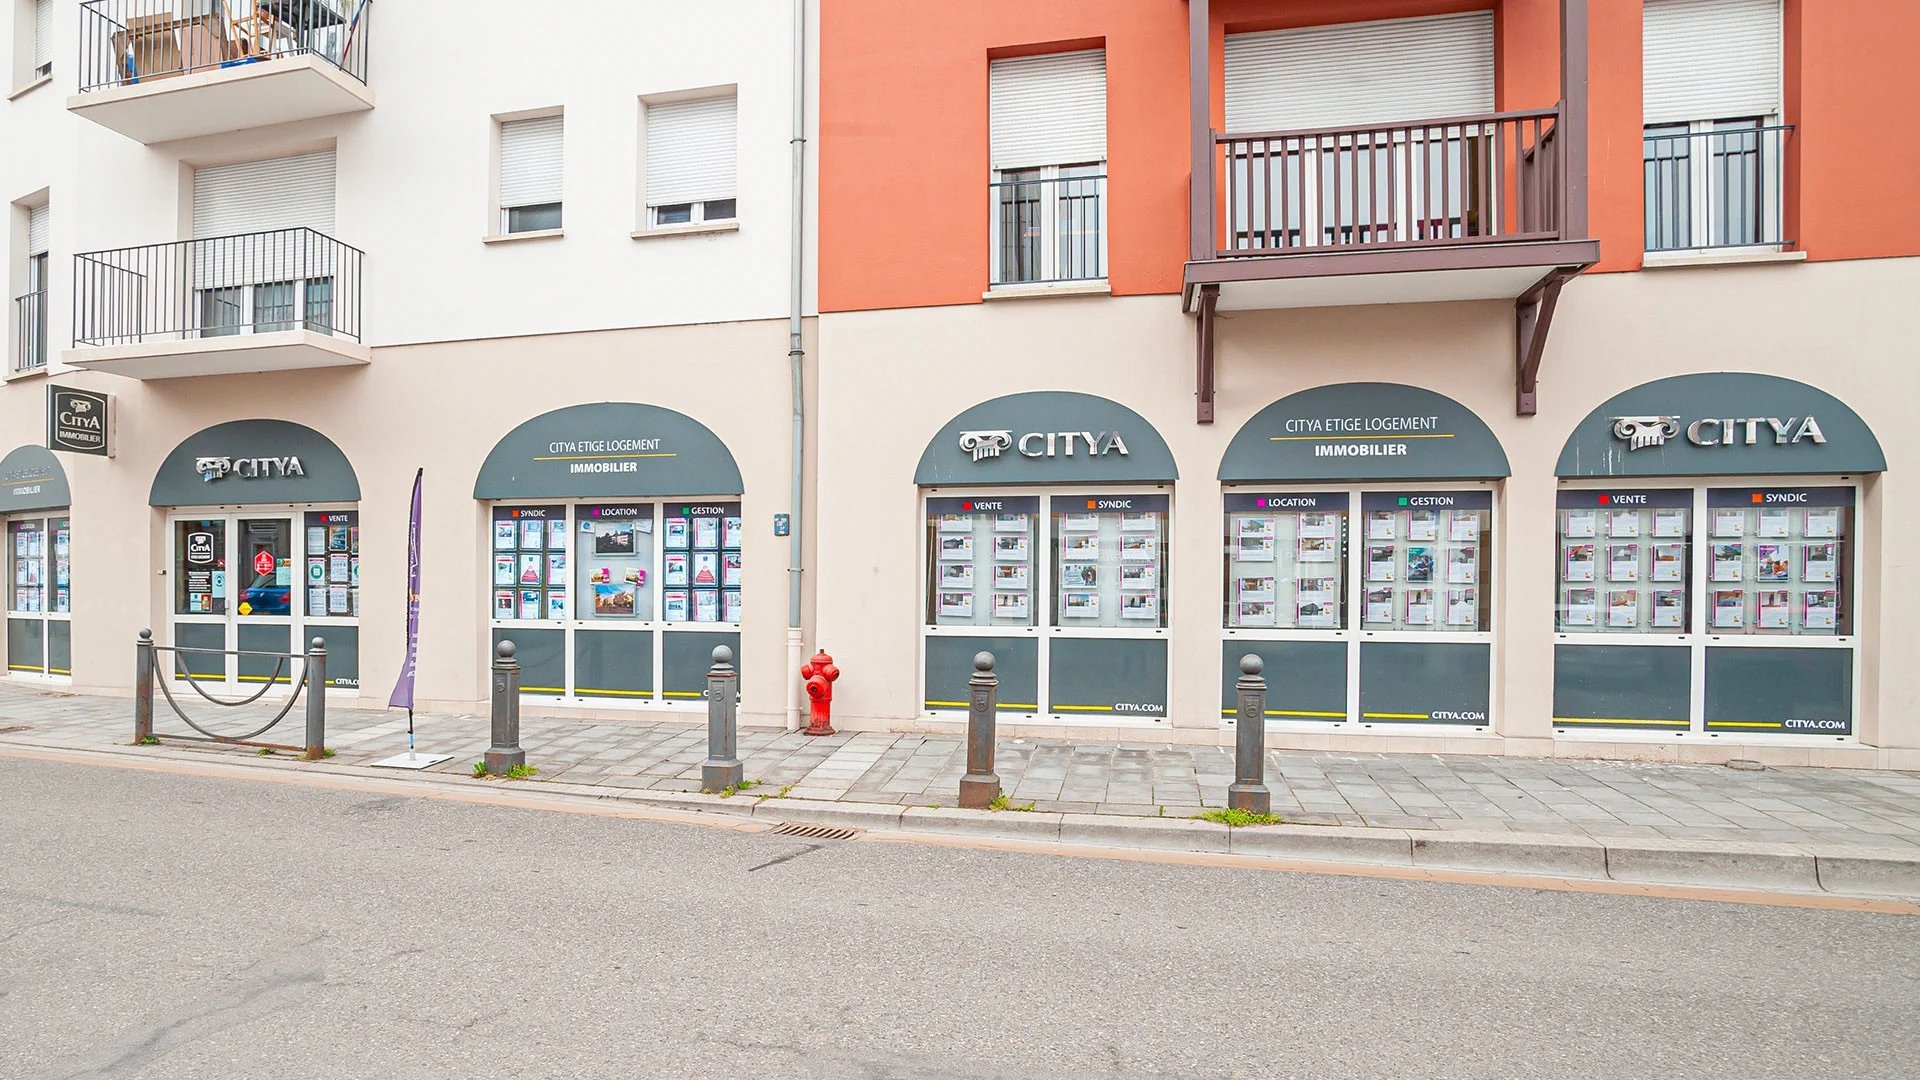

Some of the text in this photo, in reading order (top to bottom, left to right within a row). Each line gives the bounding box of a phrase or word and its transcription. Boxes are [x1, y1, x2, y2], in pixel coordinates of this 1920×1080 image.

[59, 411, 101, 429] CITYA
[1285, 416, 1439, 433] CITYA ETIGE LOGEMENT
[1687, 415, 1827, 446] CITYA
[59, 430, 101, 443] IMMOBILIER
[549, 438, 660, 453] CITYA ETIGE LOGEMENT
[1018, 430, 1129, 458] CITYA
[1315, 444, 1407, 457] IMMOBILIER
[233, 456, 304, 478] CITYA
[570, 462, 638, 474] IMMOBILIER
[1268, 498, 1316, 507] LOCATION
[1410, 496, 1454, 506] GESTION
[1612, 495, 1647, 504] VENTE
[1766, 492, 1808, 503] SYNDIC
[974, 501, 1003, 511] VENTE
[1098, 499, 1132, 510] SYNDIC
[520, 509, 546, 518] SYNDIC
[601, 508, 638, 517] LOCATION
[691, 506, 725, 516] GESTION
[328, 515, 349, 524] VENTE
[1115, 702, 1163, 712] CITYA.COM
[1431, 711, 1485, 720] CITYA.COM
[1785, 719, 1845, 730] CITYA.COM
